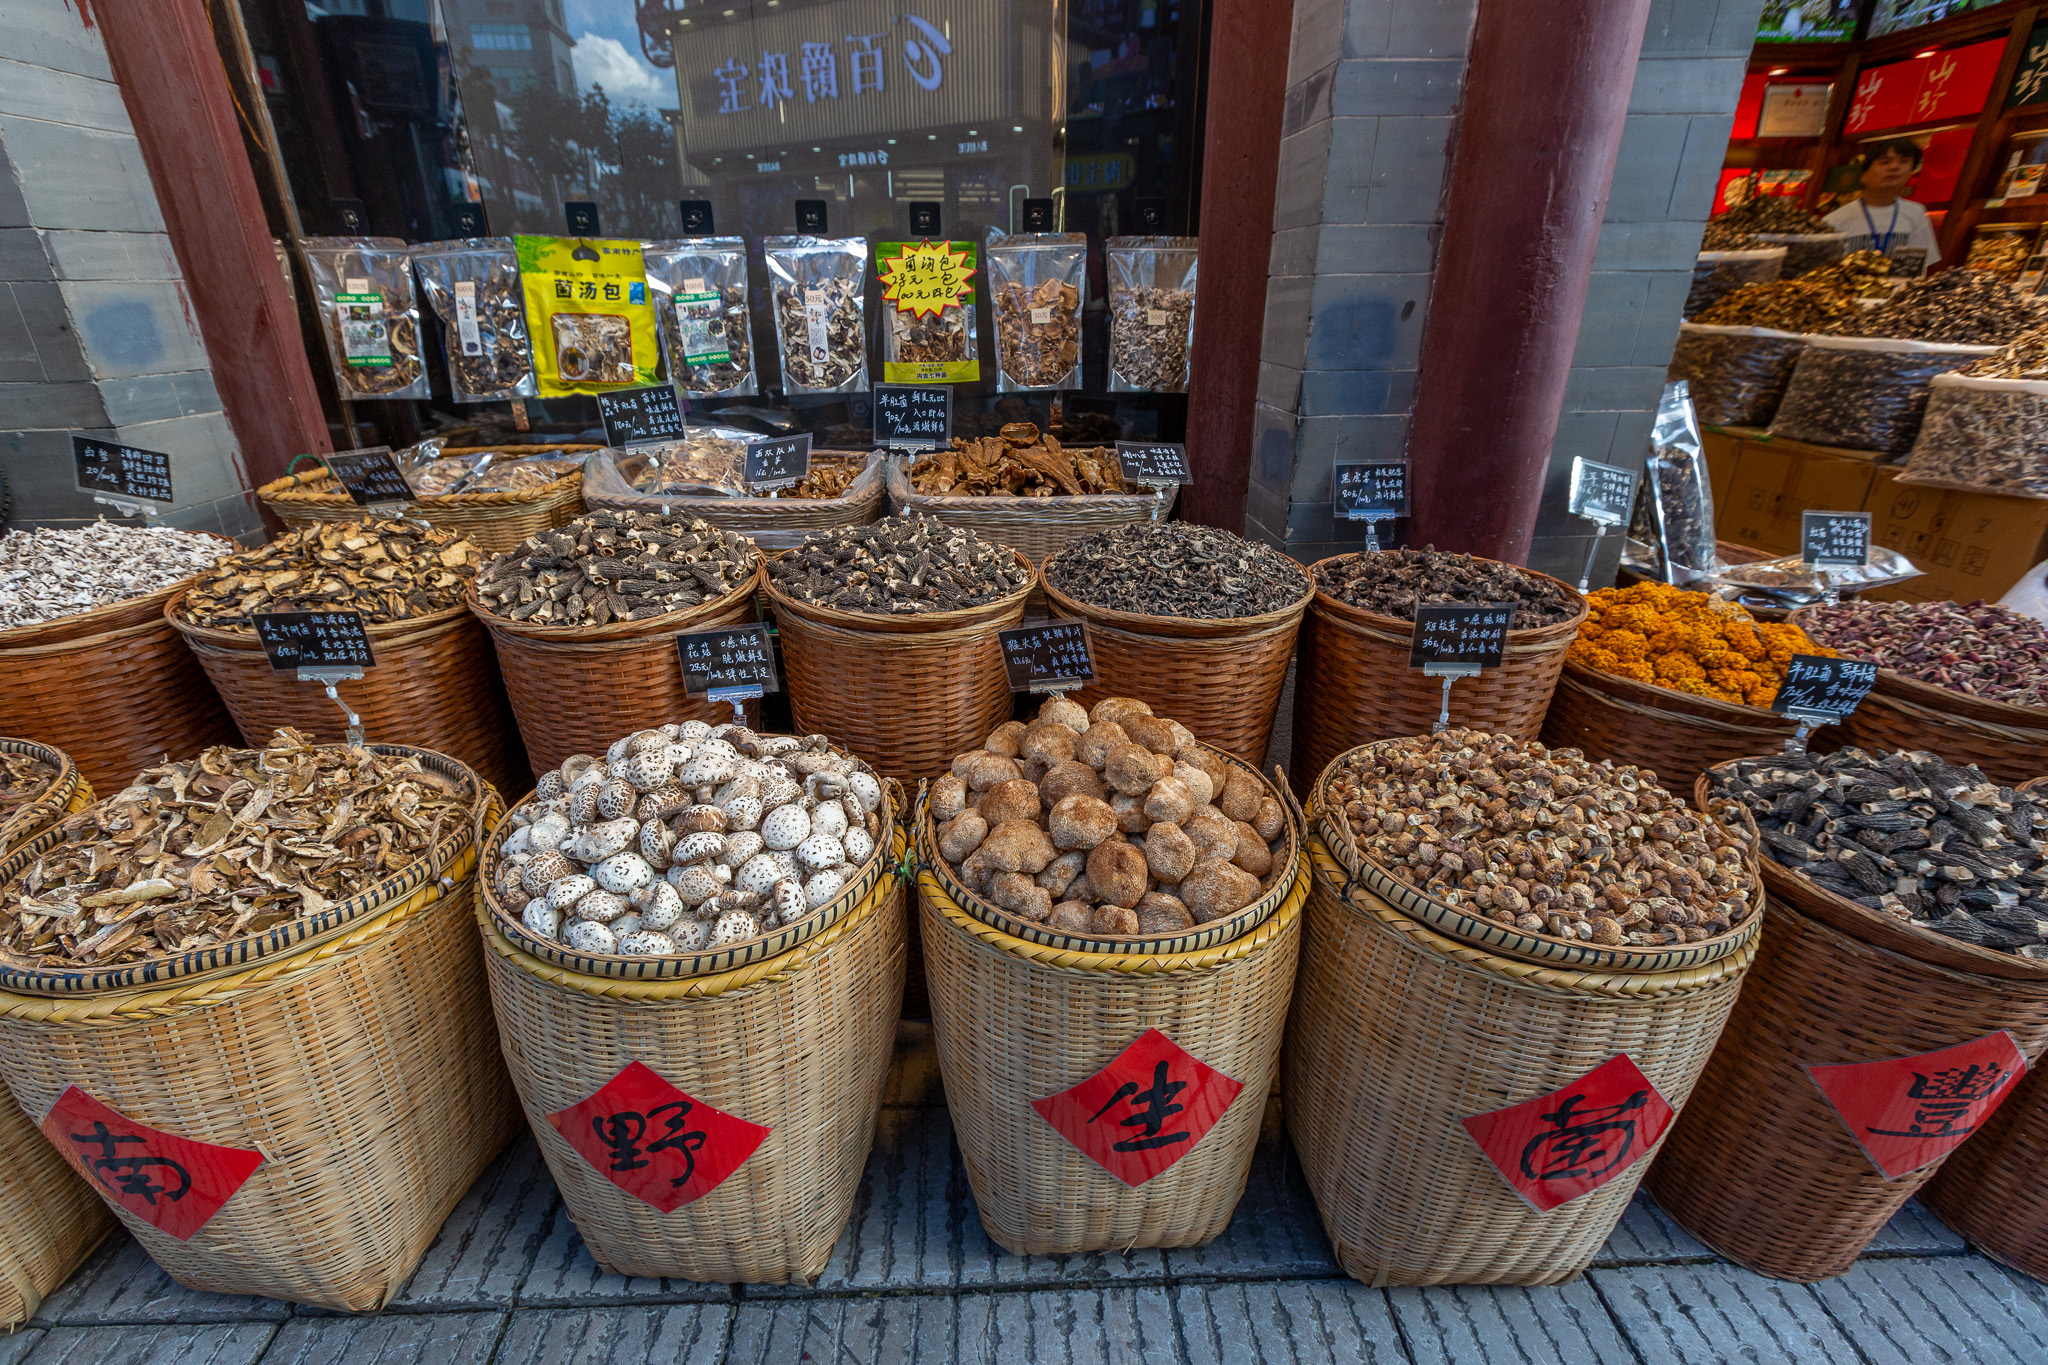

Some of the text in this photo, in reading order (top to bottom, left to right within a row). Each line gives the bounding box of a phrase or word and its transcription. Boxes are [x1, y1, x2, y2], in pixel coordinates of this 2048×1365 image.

[905, 254, 956, 272] 菌汤包
[554, 279, 621, 300] 菌汤包
[879, 394, 908, 408] 羊肚菌
[913, 408, 945, 419] 入口即化
[687, 641, 712, 659] 花菇
[1007, 635, 1042, 652] 猴头菇
[1788, 661, 1832, 682] 羊肚菌
[1087, 1060, 1191, 1153] 生
[592, 1100, 707, 1188] 野
[1520, 1090, 1649, 1180] 菌
